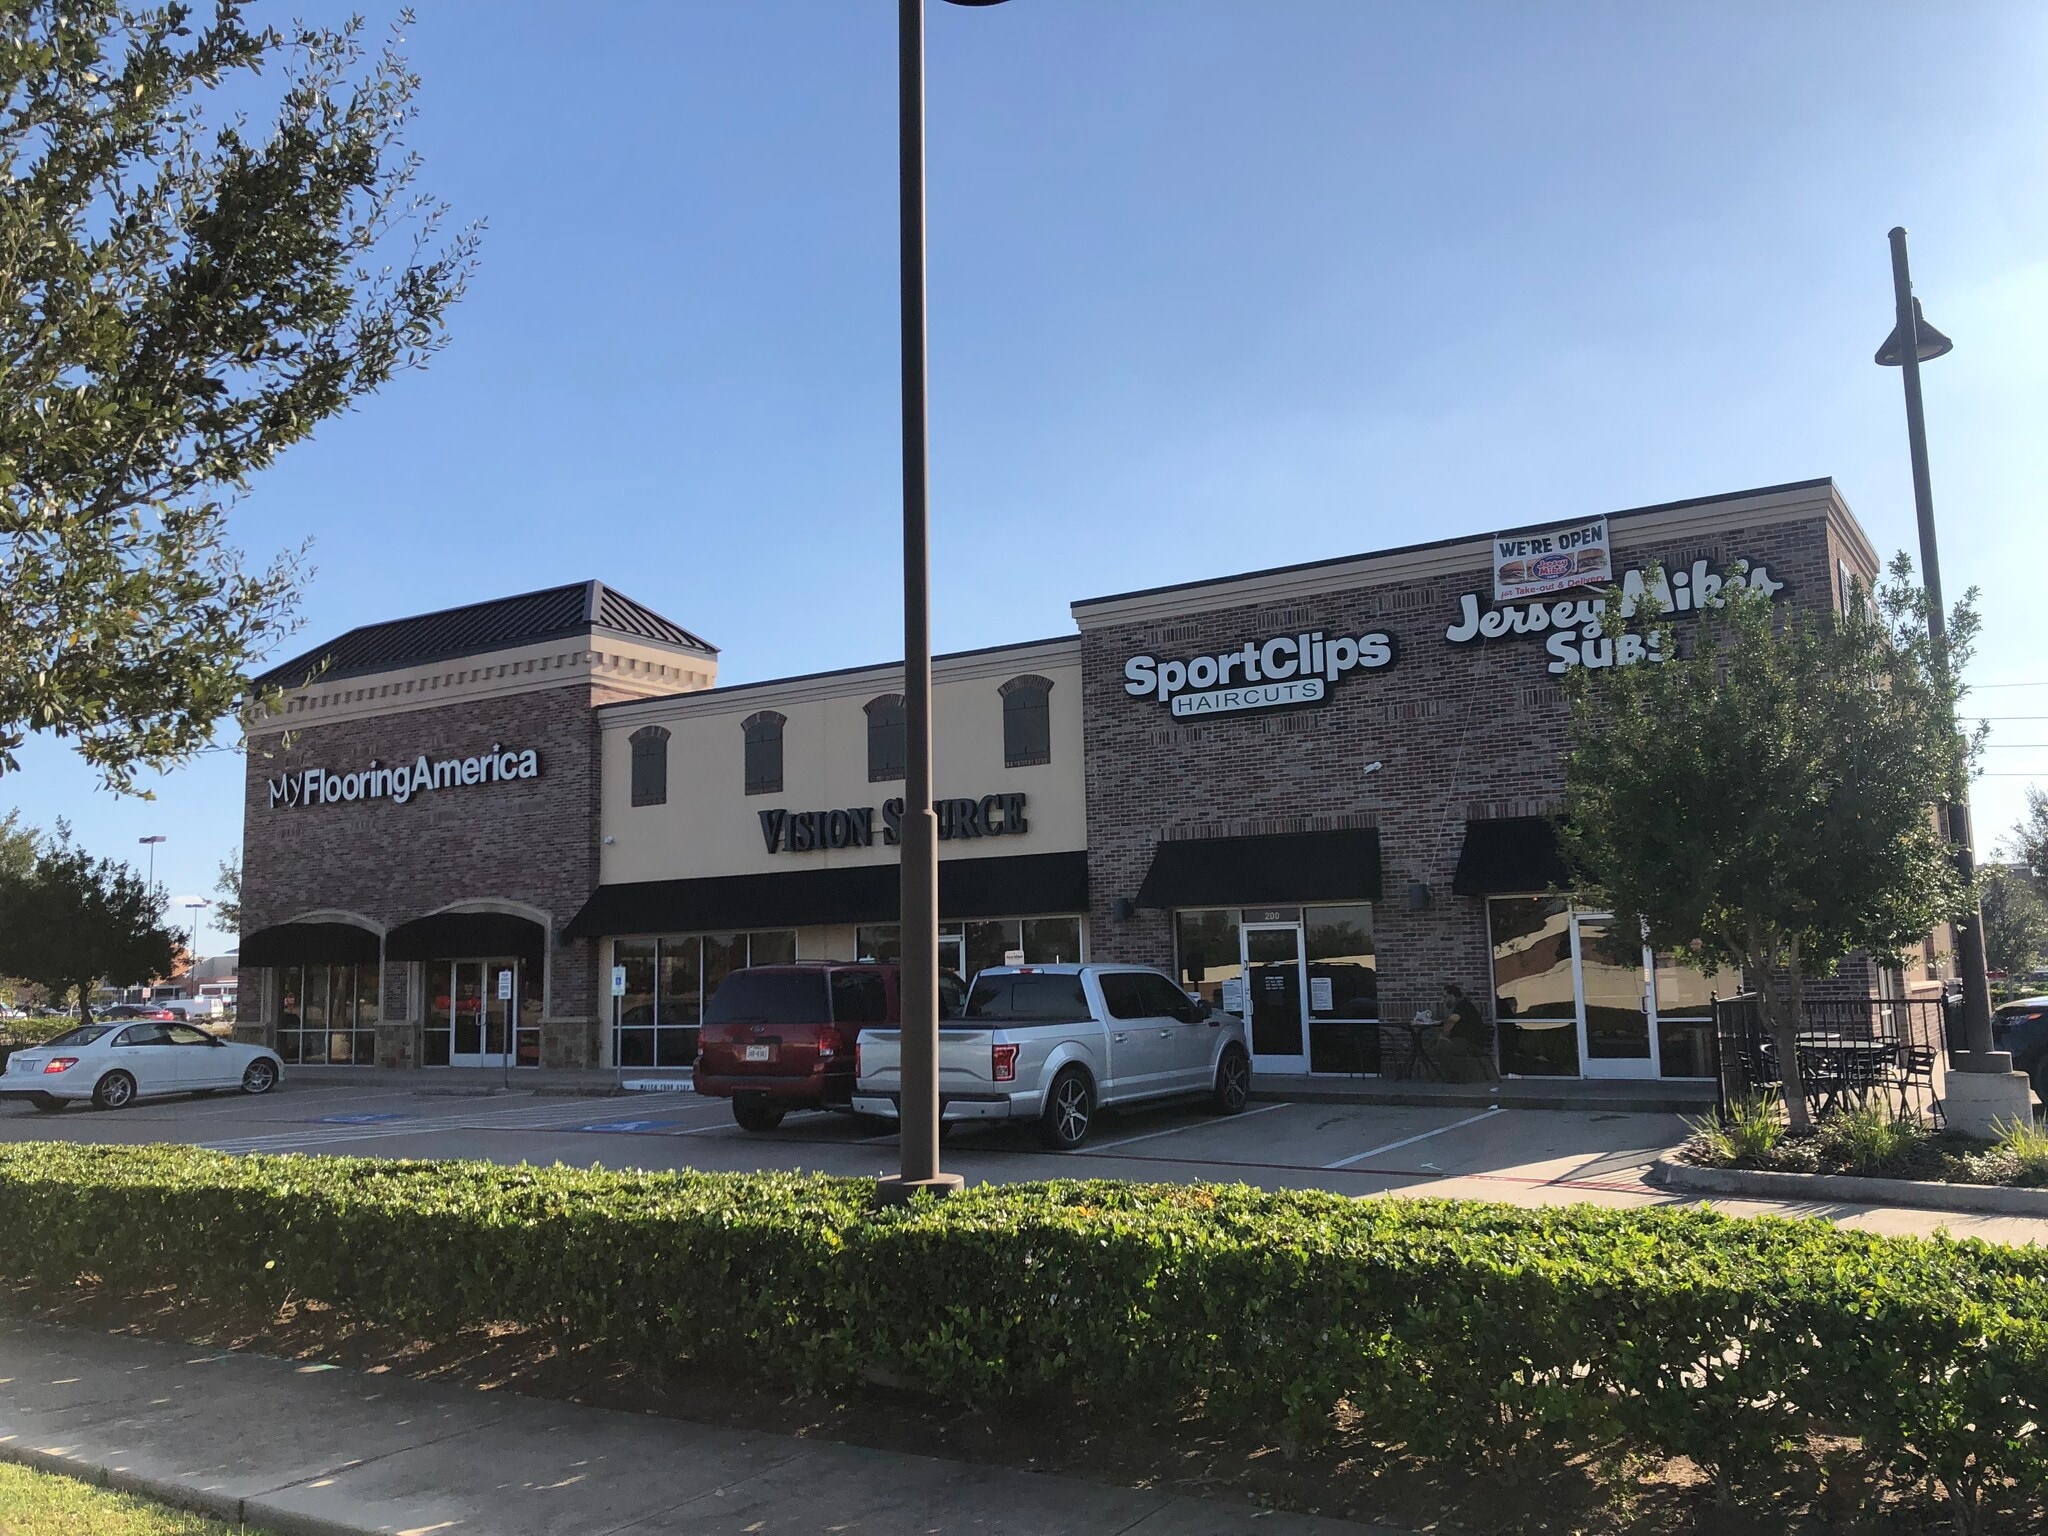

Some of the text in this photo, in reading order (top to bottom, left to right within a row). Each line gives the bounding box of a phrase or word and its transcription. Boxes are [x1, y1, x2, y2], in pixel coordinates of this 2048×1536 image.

[1499, 525, 1602, 558] WE'RE OPEN
[1515, 582, 1554, 595] Take-out
[1558, 580, 1564, 589] &
[1446, 594, 1605, 641] Jersey
[1178, 682, 1318, 713] HAIRCUTS
[758, 793, 1027, 854] VISION SURCE
[1264, 911, 1280, 920] 200
